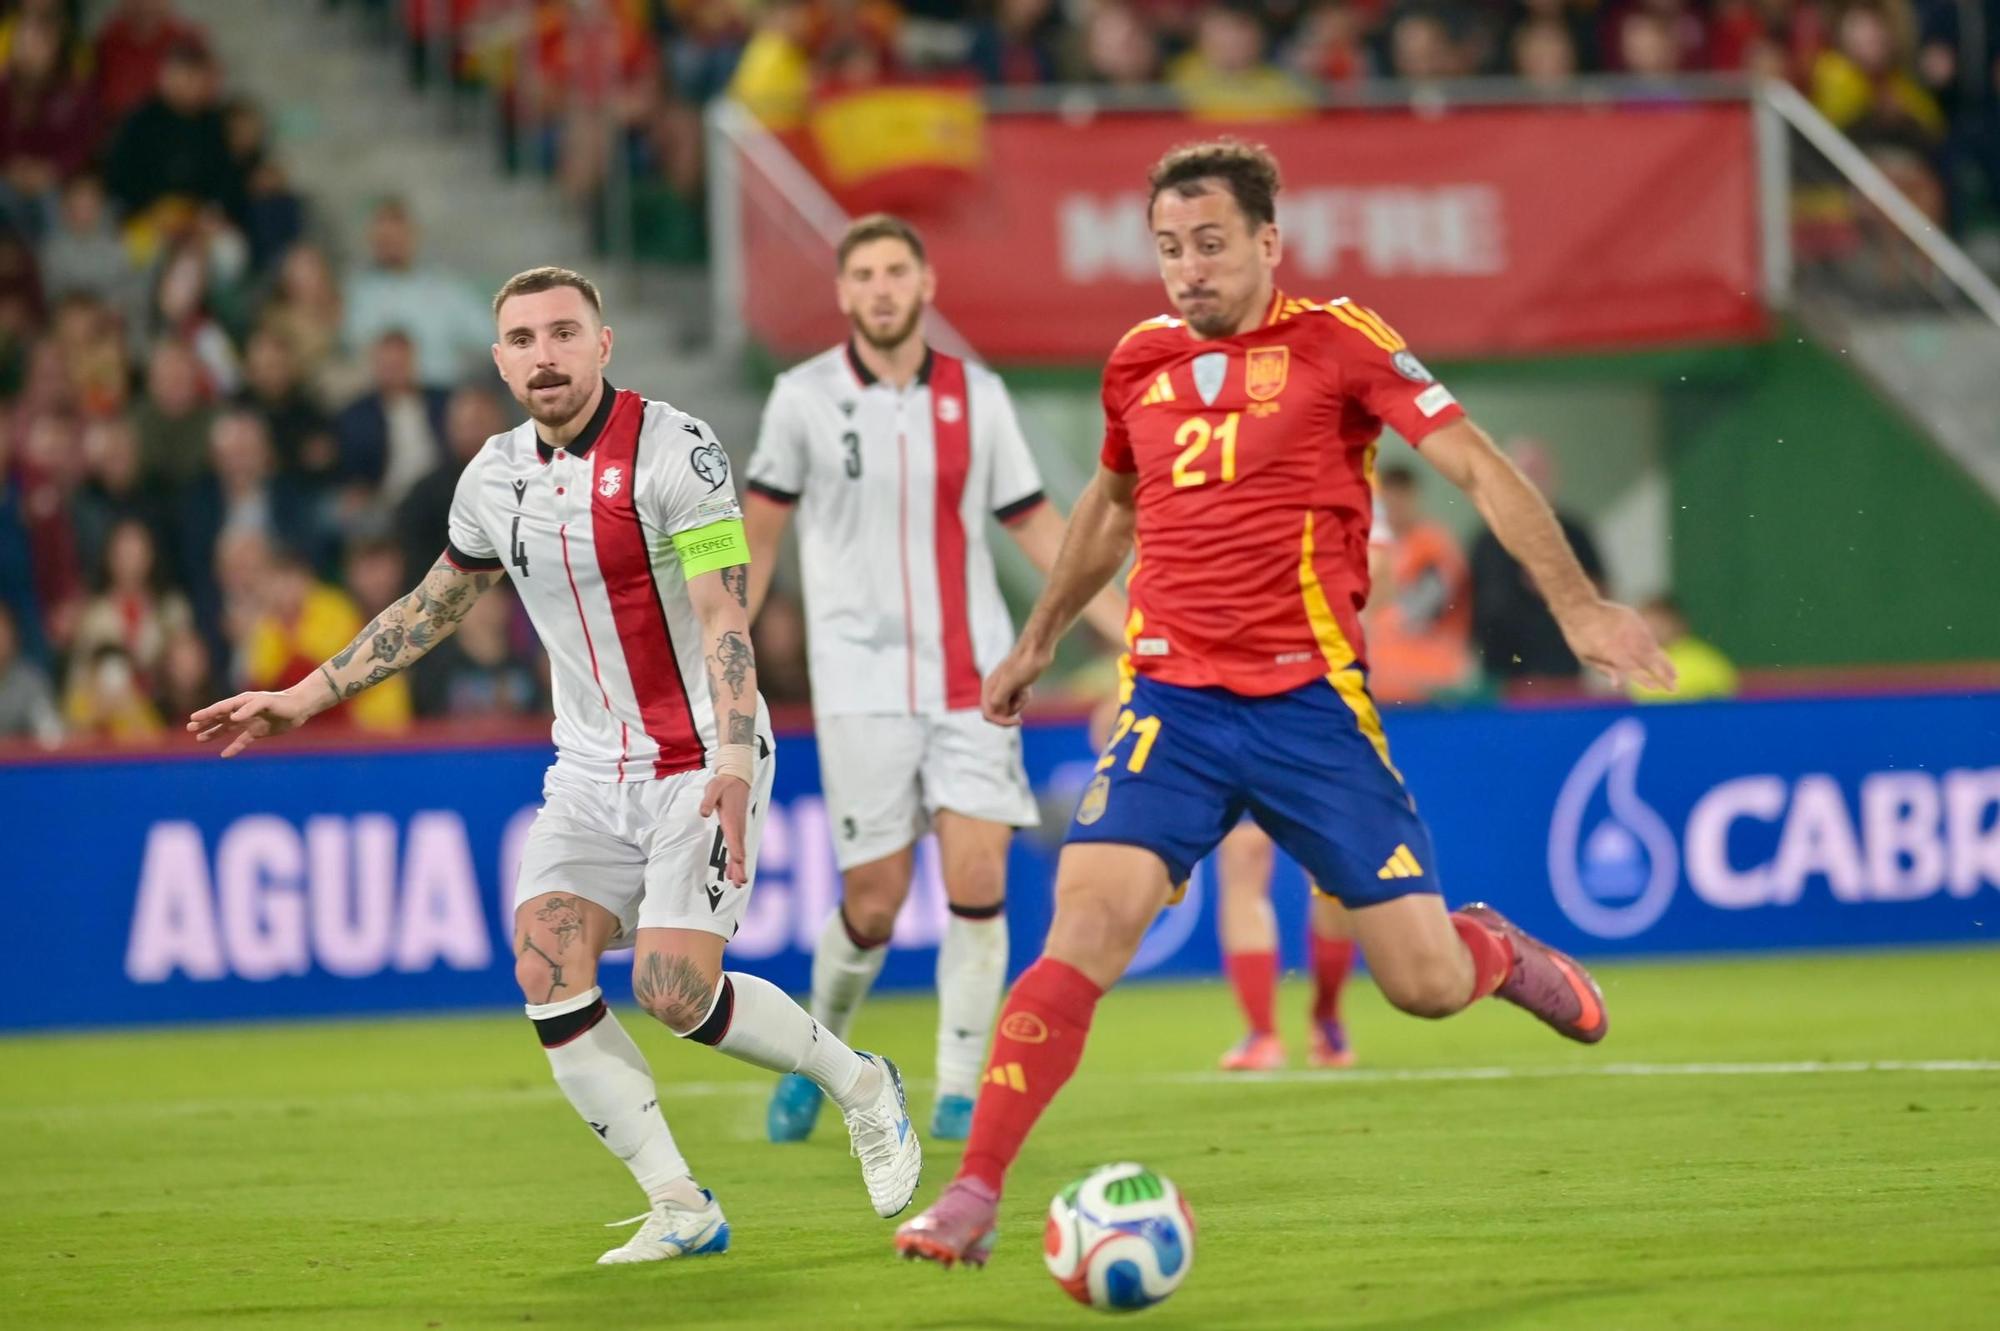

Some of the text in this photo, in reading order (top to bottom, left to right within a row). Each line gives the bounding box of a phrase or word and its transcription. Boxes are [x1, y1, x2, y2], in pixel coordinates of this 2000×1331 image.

[842, 432, 862, 479] 3
[1172, 412, 1240, 488] 21
[511, 516, 529, 578] 4
[688, 535, 735, 556] RESPECT
[1094, 709, 1162, 774] 21
[708, 824, 728, 882] 4
[124, 808, 492, 982] AGUA
